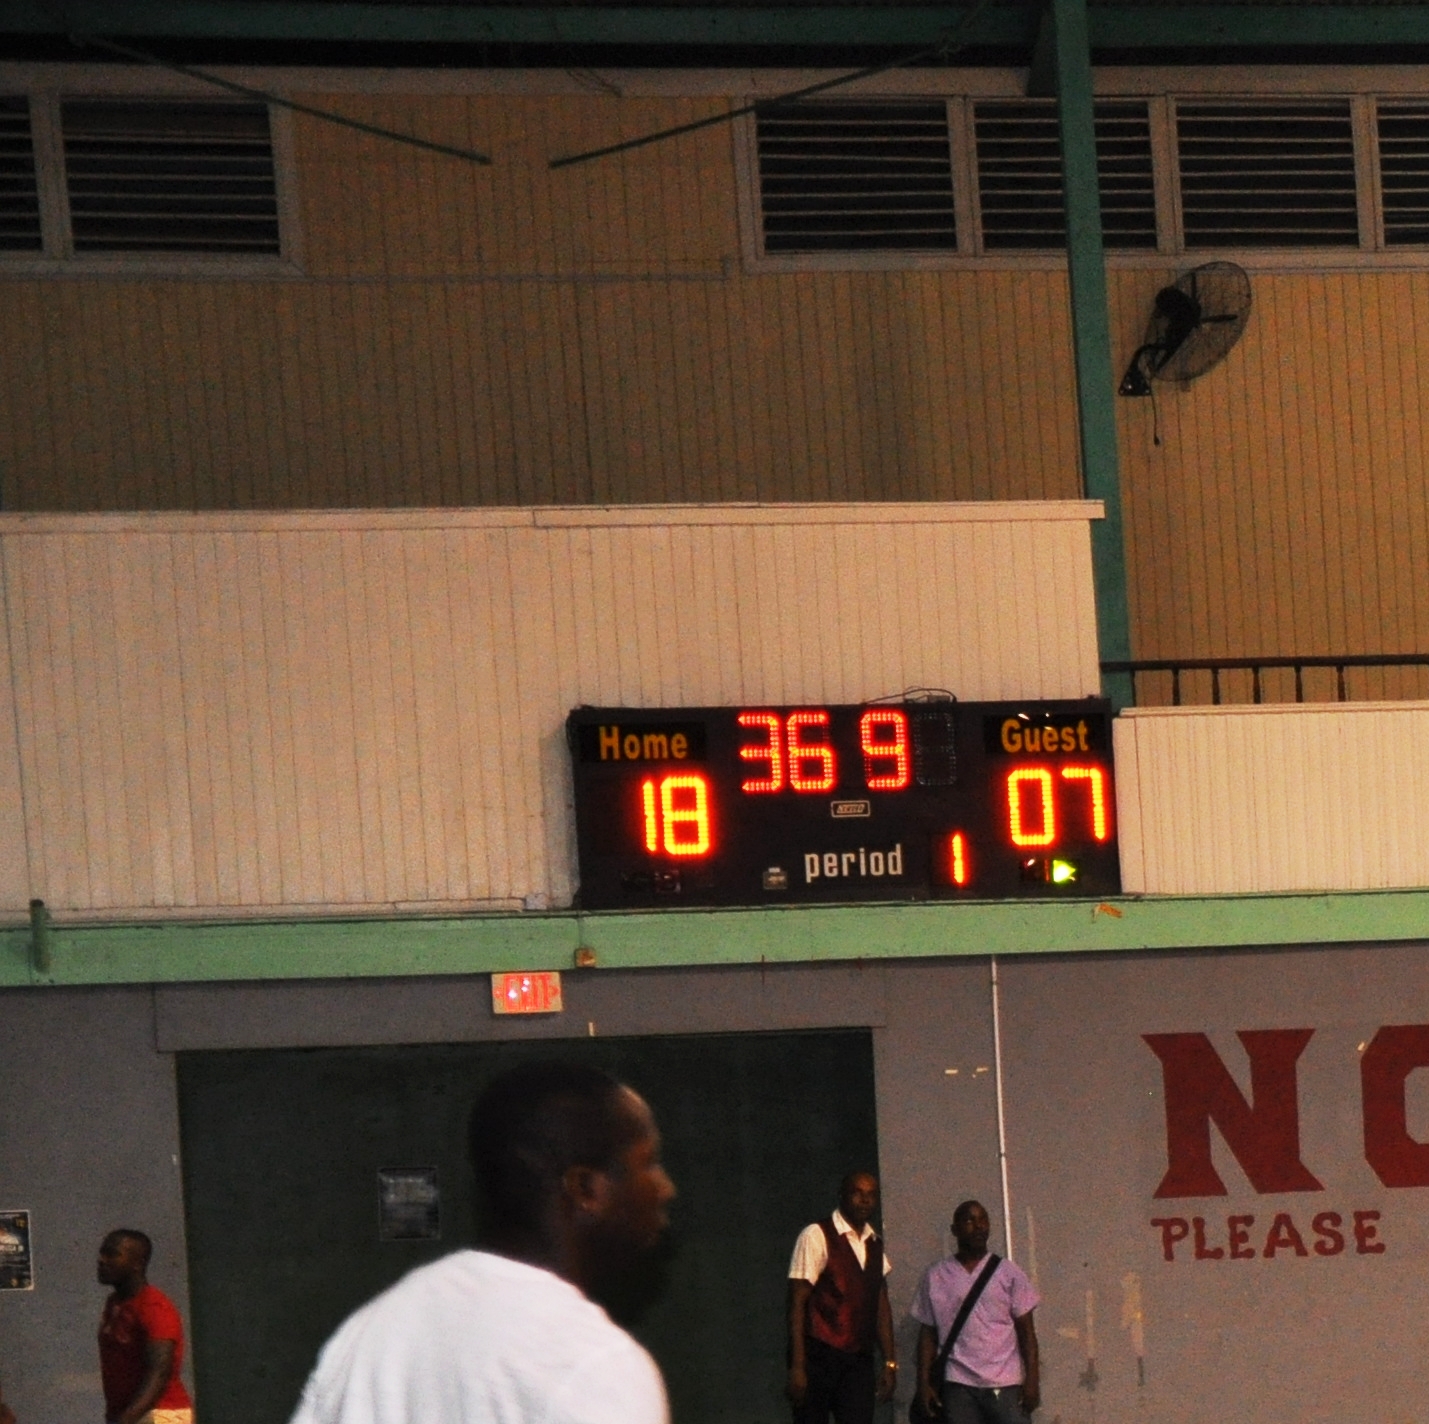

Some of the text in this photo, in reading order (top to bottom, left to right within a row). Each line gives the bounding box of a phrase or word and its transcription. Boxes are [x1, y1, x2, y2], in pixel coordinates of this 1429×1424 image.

[600, 726, 688, 760] Home
[1001, 719, 1090, 754] Guest
[642, 774, 711, 856] 18
[1006, 767, 1107, 847] 07
[804, 832, 964, 885] period 1
[1150, 1209, 1386, 1263] PLEASE
